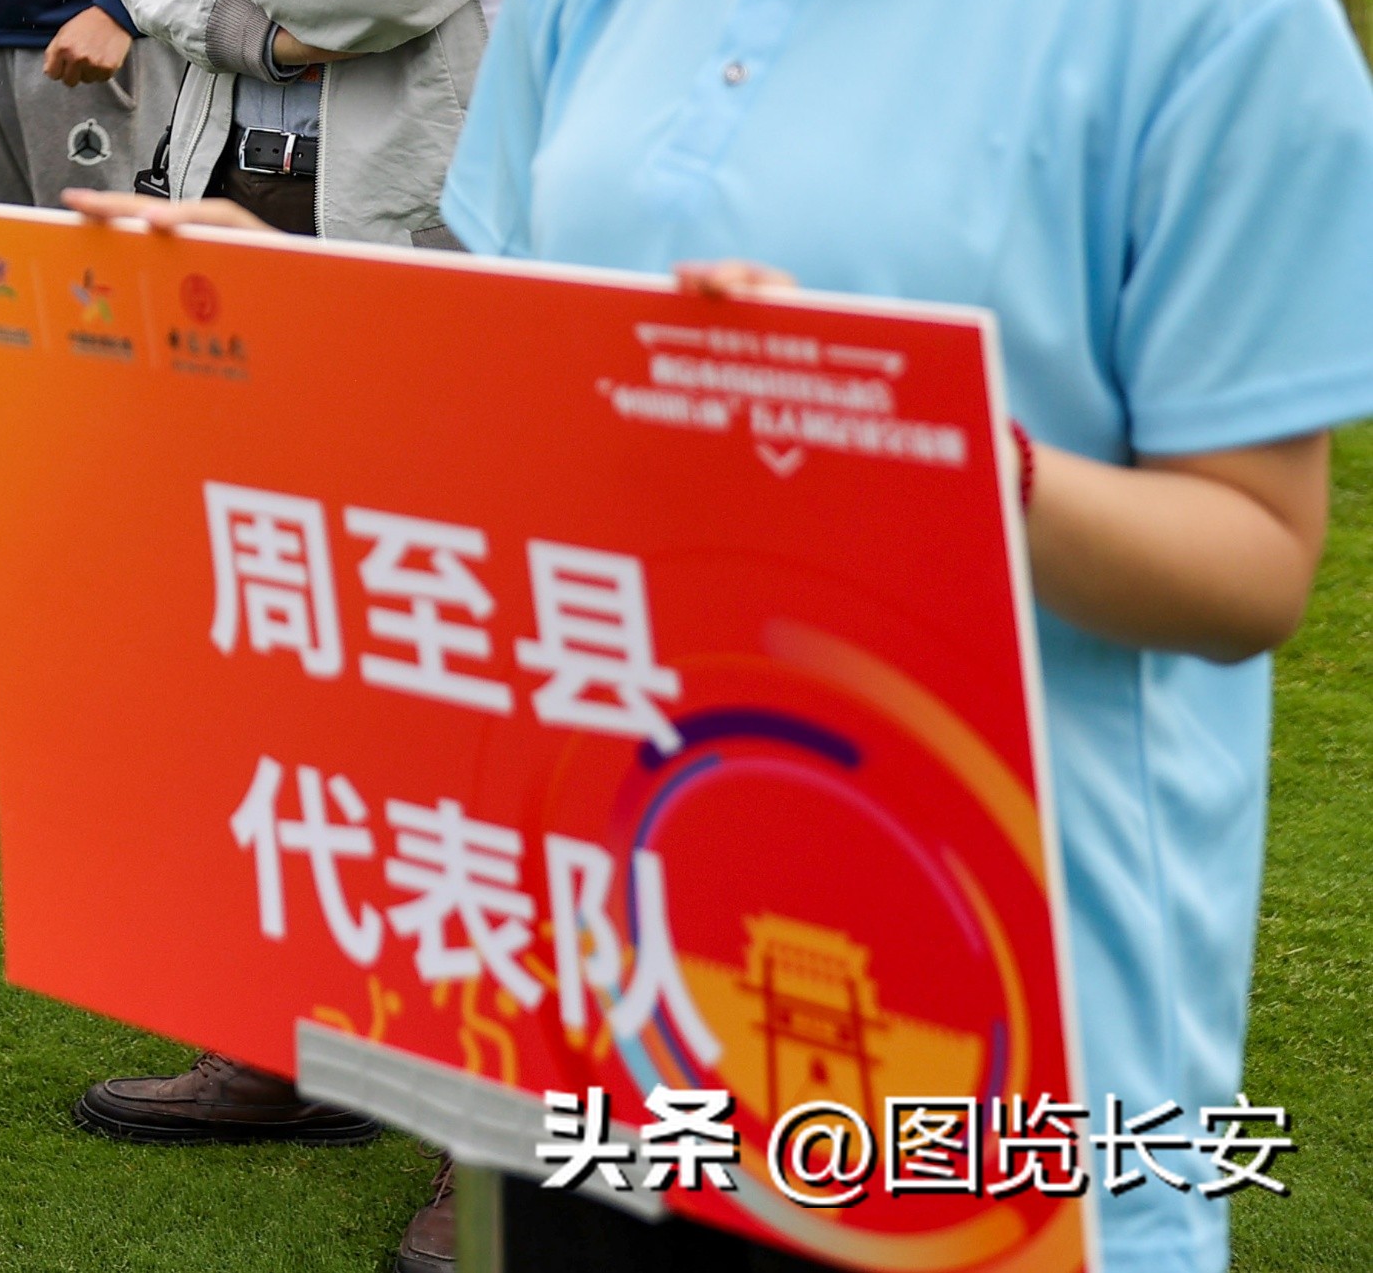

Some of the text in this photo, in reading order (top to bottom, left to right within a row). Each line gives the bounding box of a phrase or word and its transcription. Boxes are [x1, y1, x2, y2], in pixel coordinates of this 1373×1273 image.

[202, 480, 682, 752] 周至县
[228, 754, 722, 1068] 代表队
